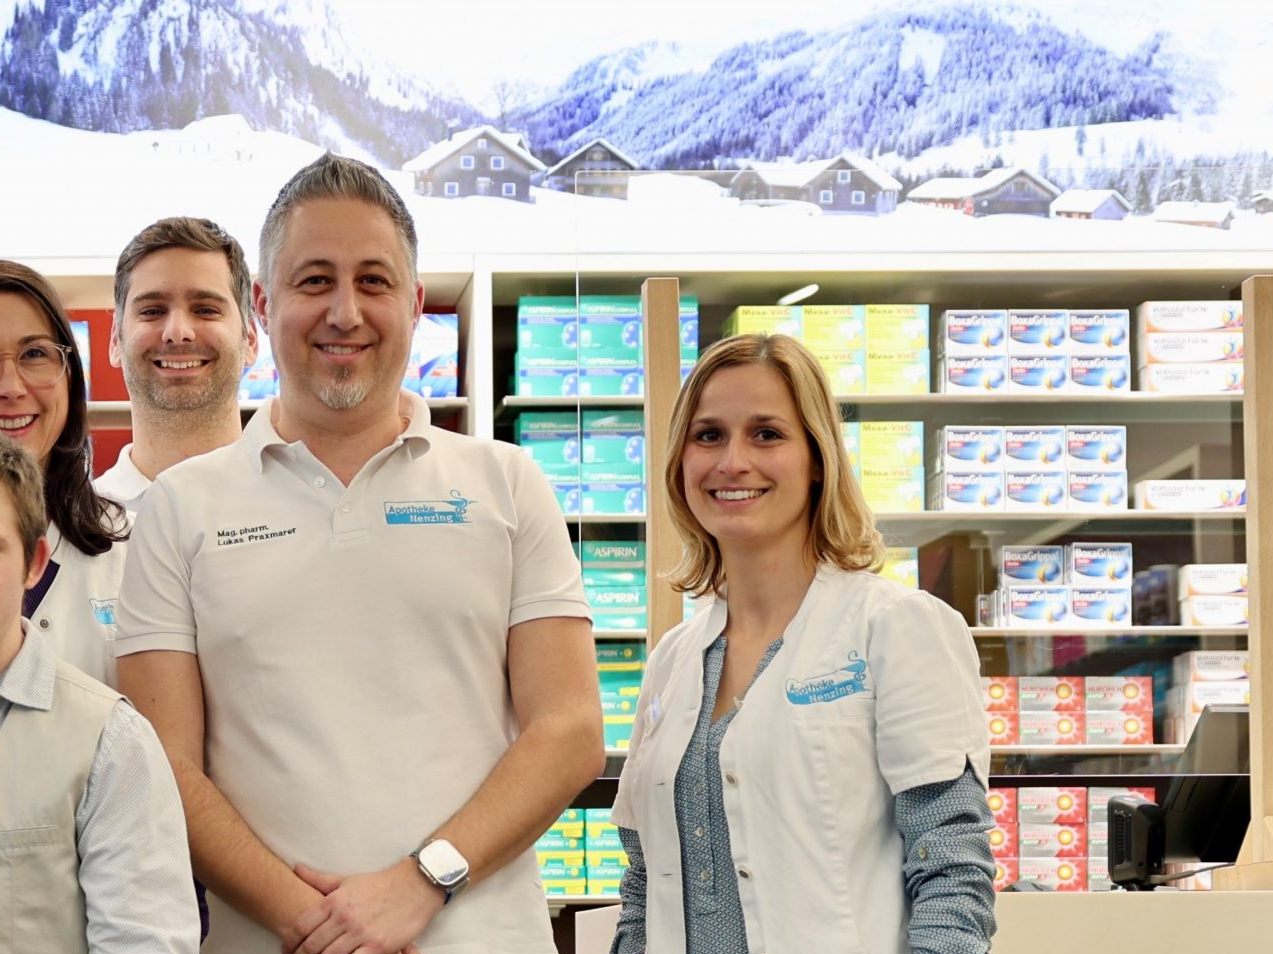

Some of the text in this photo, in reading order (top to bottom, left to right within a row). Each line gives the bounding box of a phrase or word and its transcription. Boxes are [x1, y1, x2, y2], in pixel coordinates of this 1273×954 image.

[389, 505, 435, 514] Apotheke
[410, 513, 453, 523] Nenzing
[217, 525, 269, 538] Mag. pharm.
[217, 537, 244, 546] Lukas
[594, 546, 637, 557] ASPIRIN
[1006, 550, 1060, 561] BoxaGrippal
[1075, 548, 1128, 560] BoxaGrippal
[596, 592, 640, 603] ASPIRIN
[809, 684, 855, 703] Nenzing
